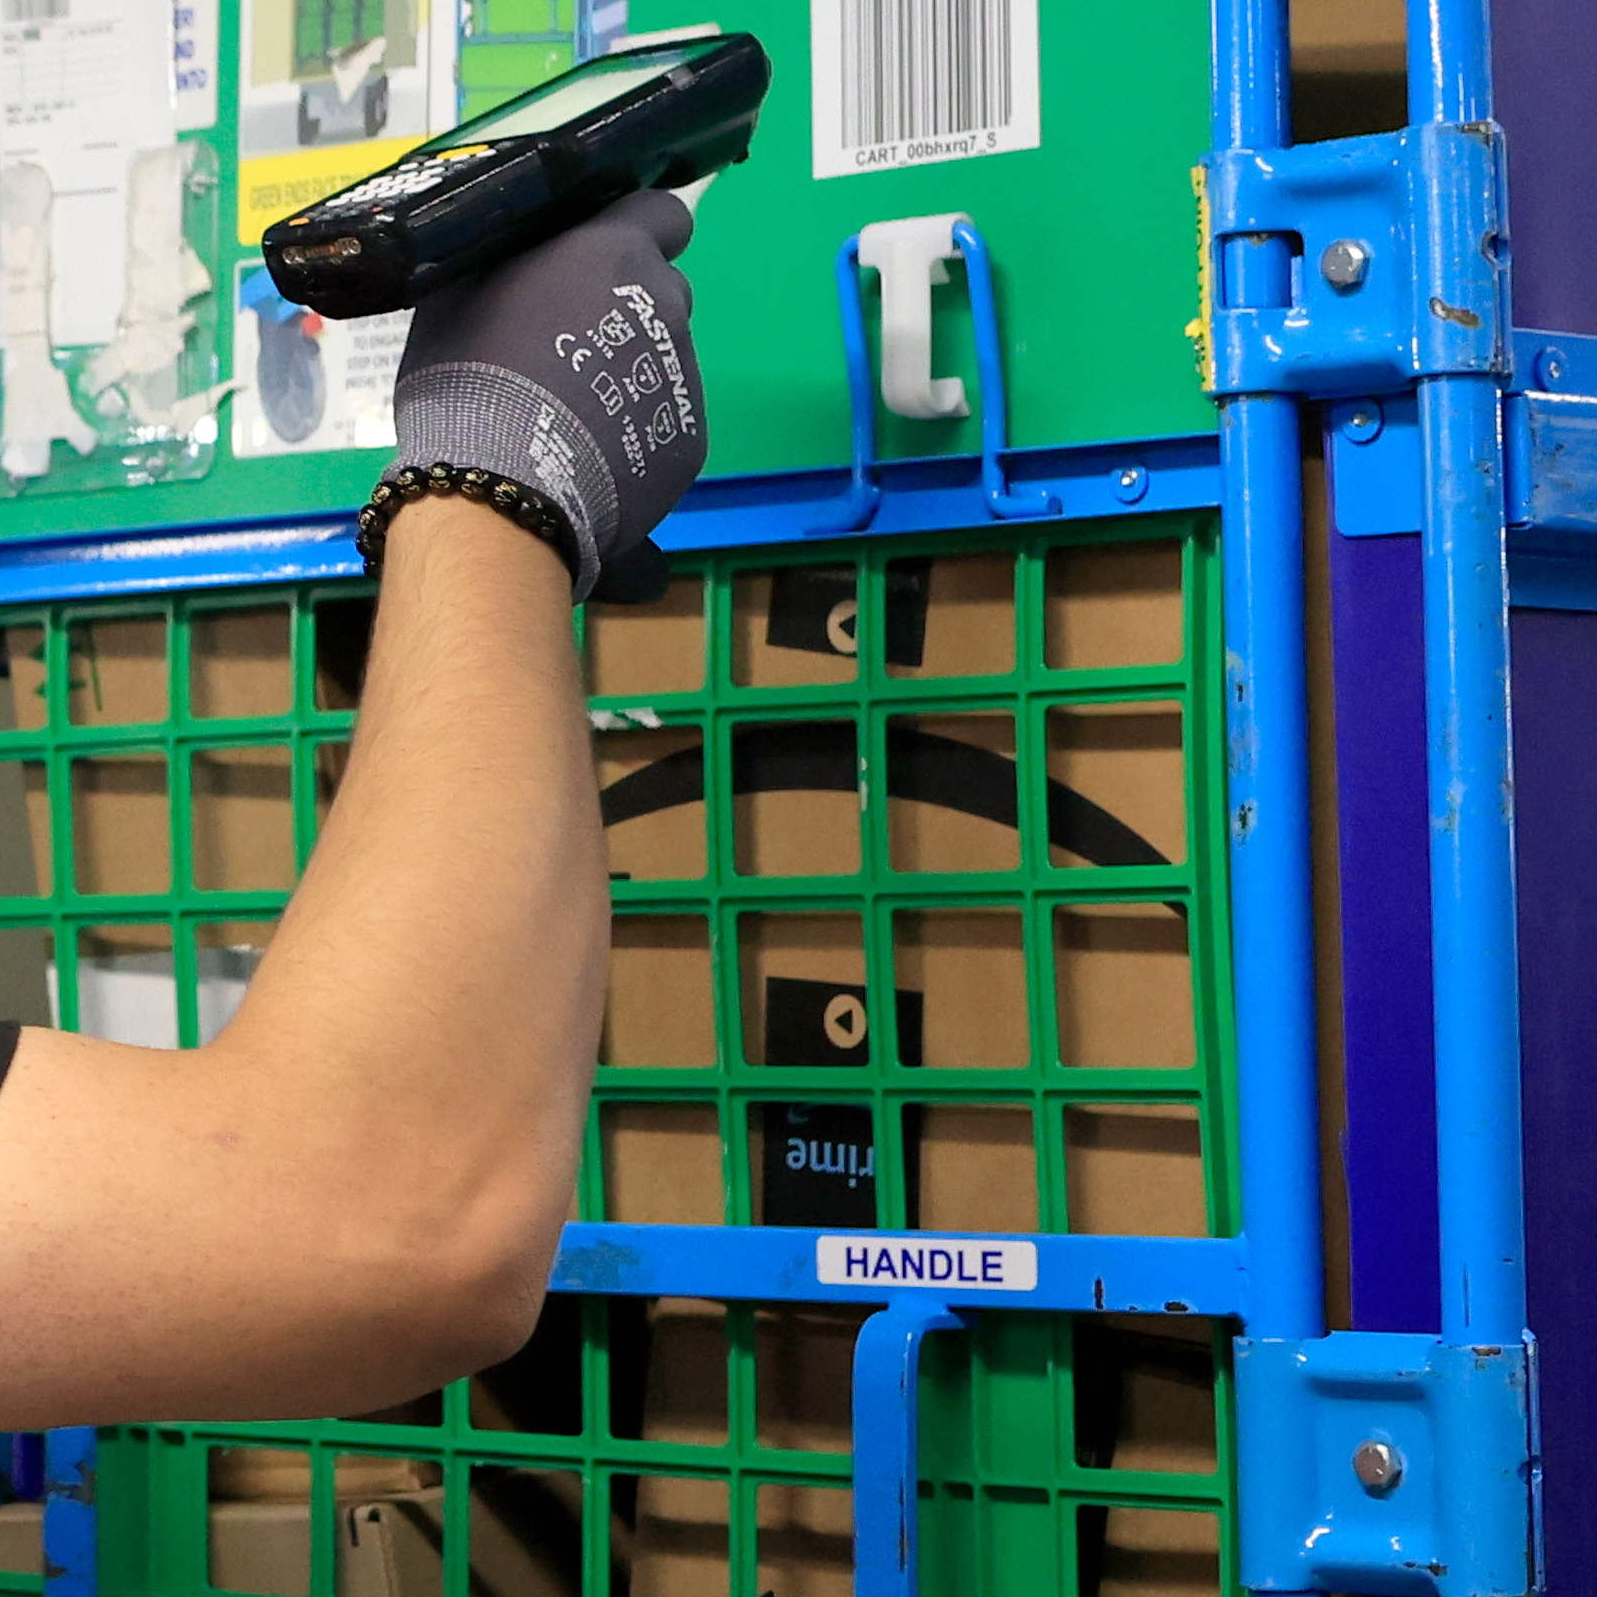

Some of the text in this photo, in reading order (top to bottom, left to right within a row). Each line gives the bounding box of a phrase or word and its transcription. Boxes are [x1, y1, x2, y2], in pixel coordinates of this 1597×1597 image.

[855, 131, 997, 167] CART_00bhxrq7_S
[612, 284, 697, 434] FASTENAL
[785, 1136, 875, 1189] rime
[845, 1245, 1004, 1283] HANDLE
